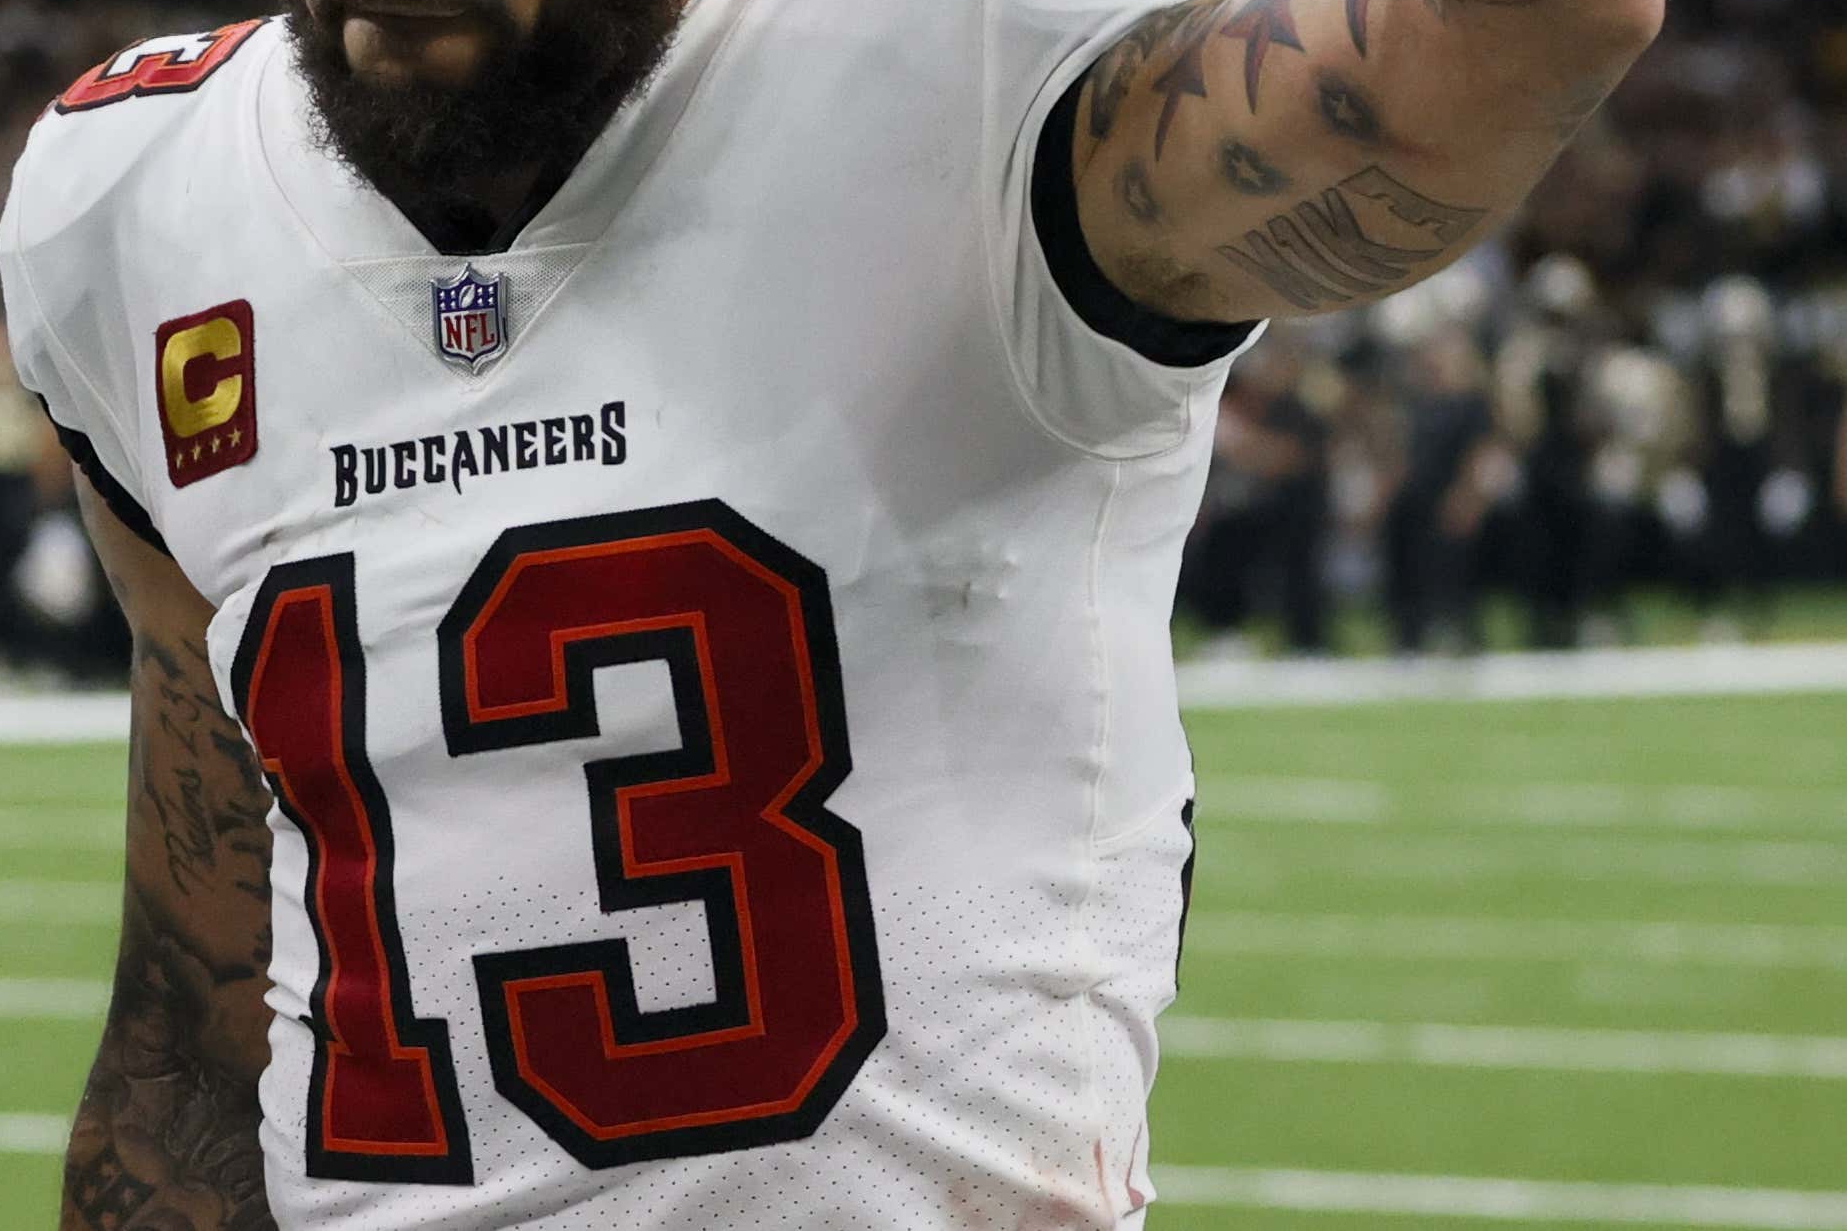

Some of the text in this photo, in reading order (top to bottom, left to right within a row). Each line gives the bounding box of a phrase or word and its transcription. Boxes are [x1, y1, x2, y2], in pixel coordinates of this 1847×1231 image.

[162, 316, 243, 438] C
[443, 312, 495, 353] NFL
[329, 400, 627, 508] BUCCANEERS
[229, 496, 888, 1186] 13
